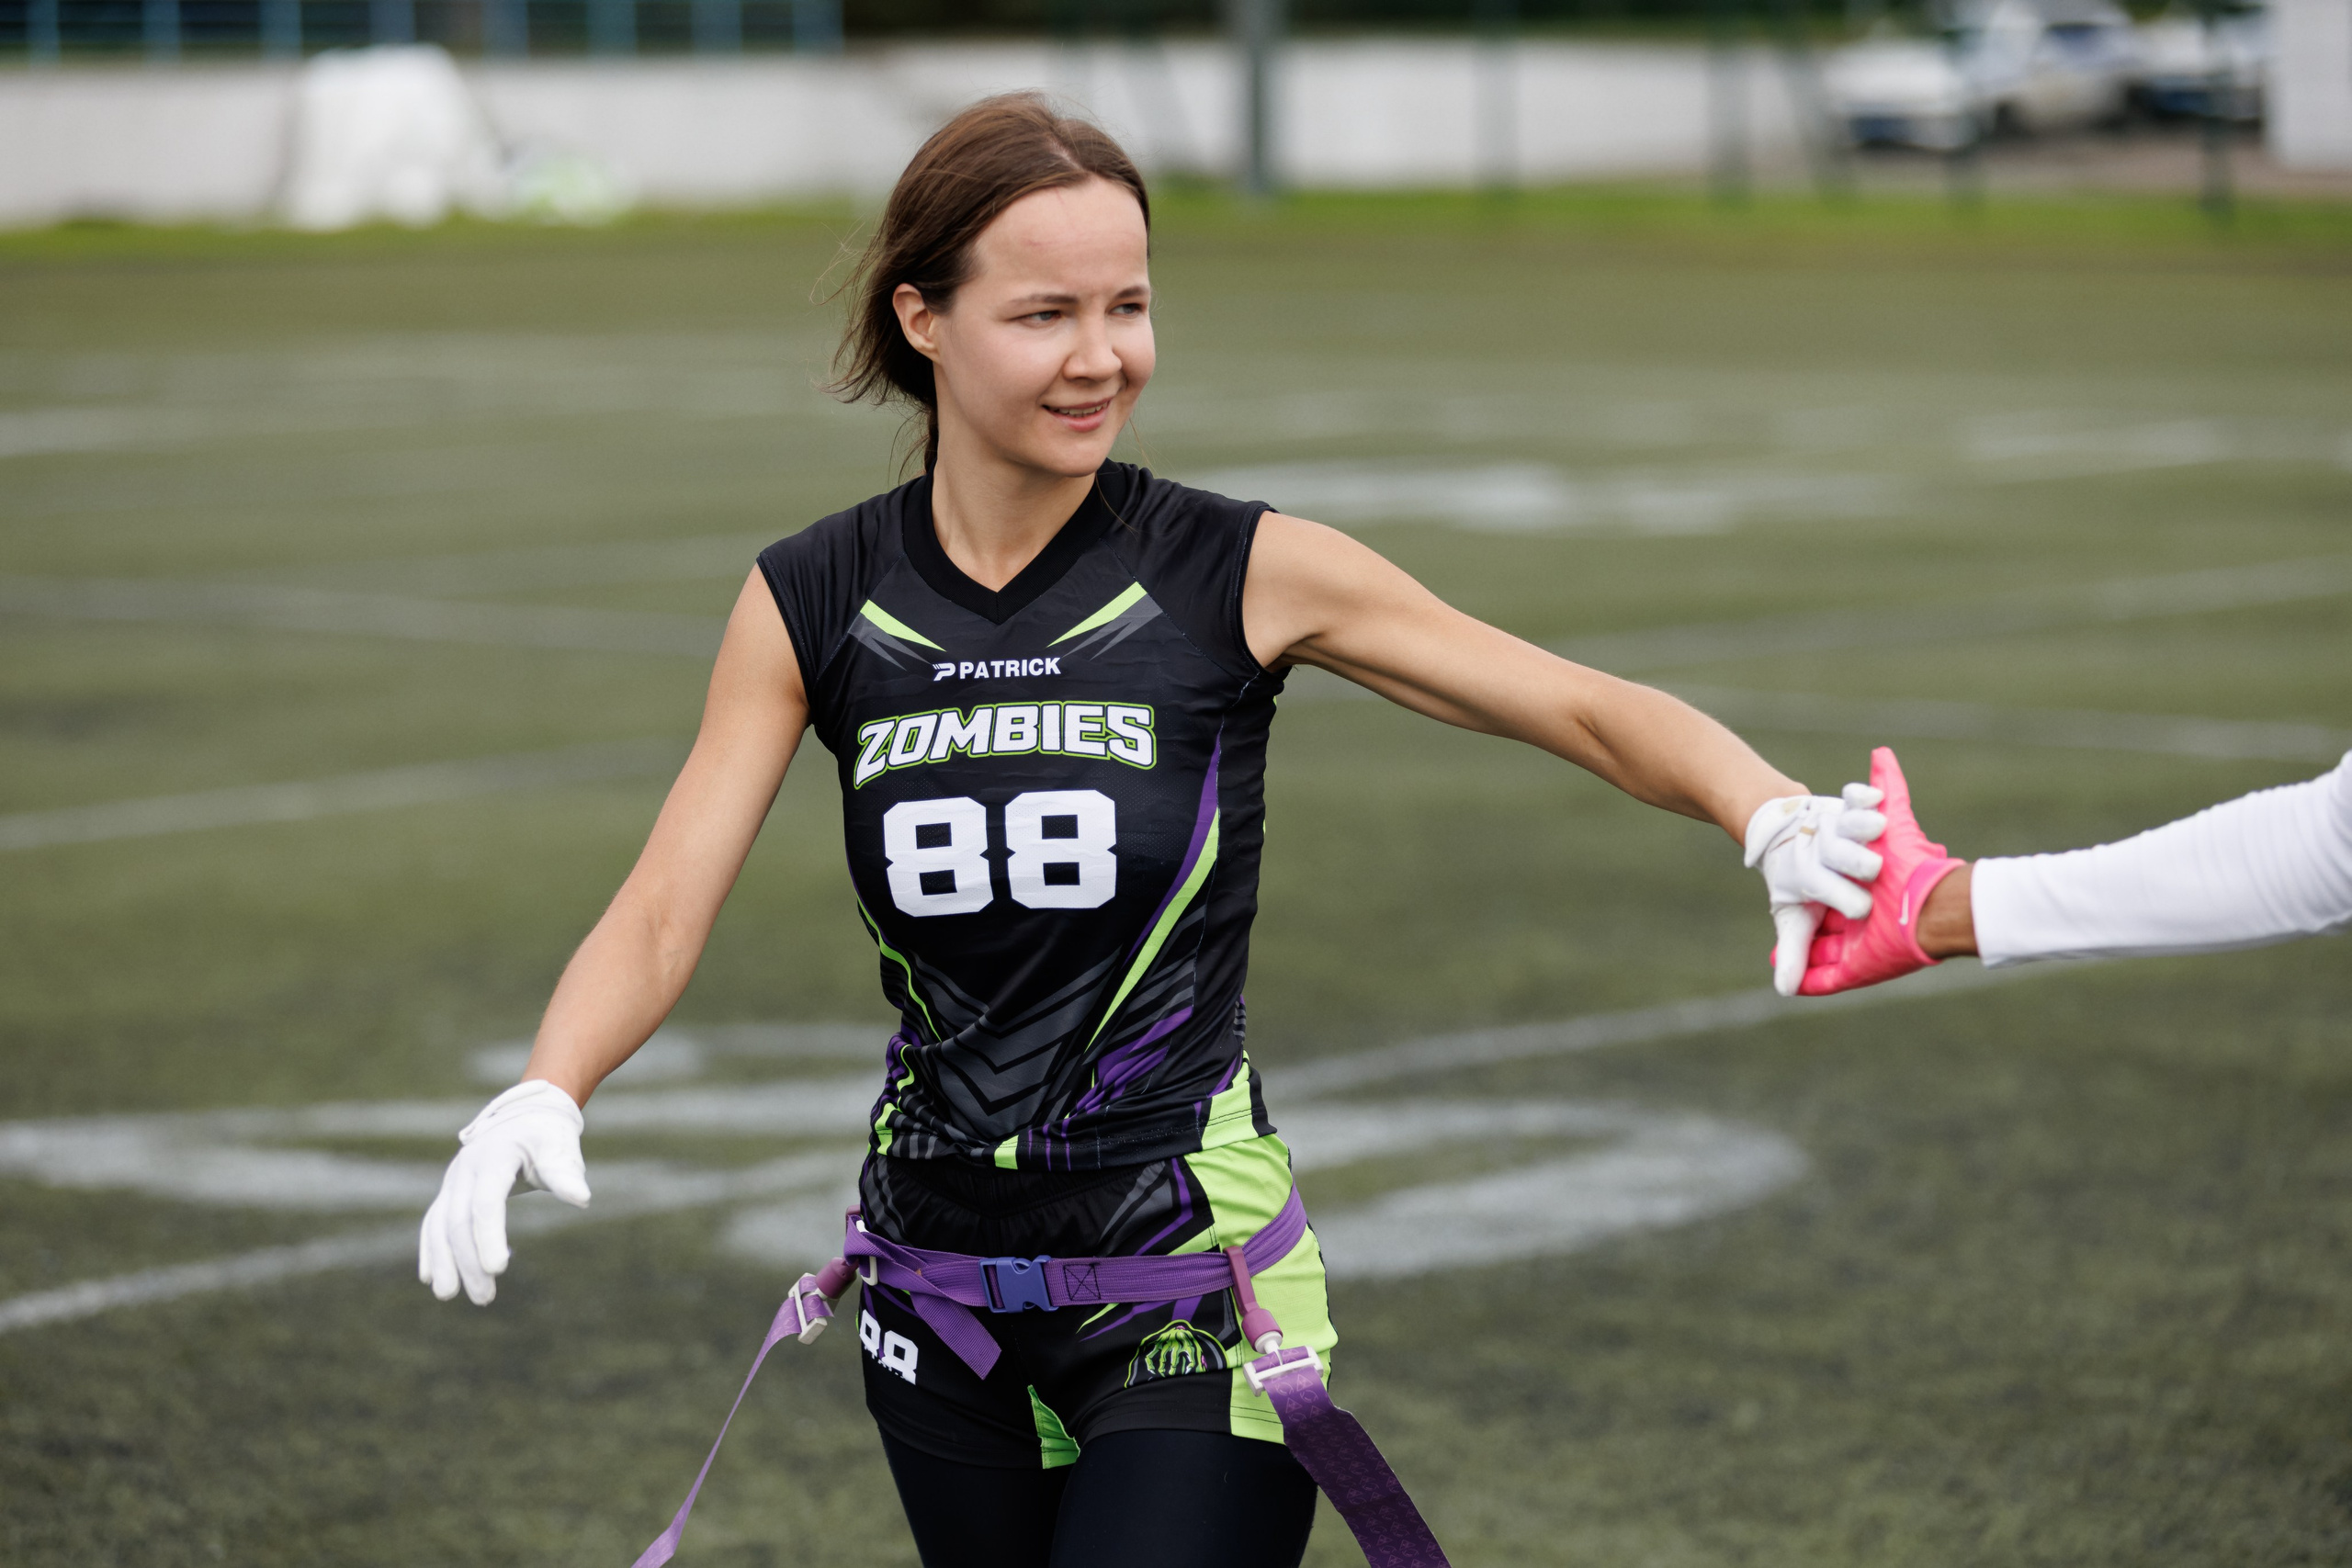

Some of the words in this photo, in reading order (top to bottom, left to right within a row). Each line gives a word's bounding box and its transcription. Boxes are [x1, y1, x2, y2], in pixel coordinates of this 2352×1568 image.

[959, 657, 1061, 680] PATRICK
[854, 701, 1157, 789] ZOMBIES
[883, 789, 1117, 918] 88
